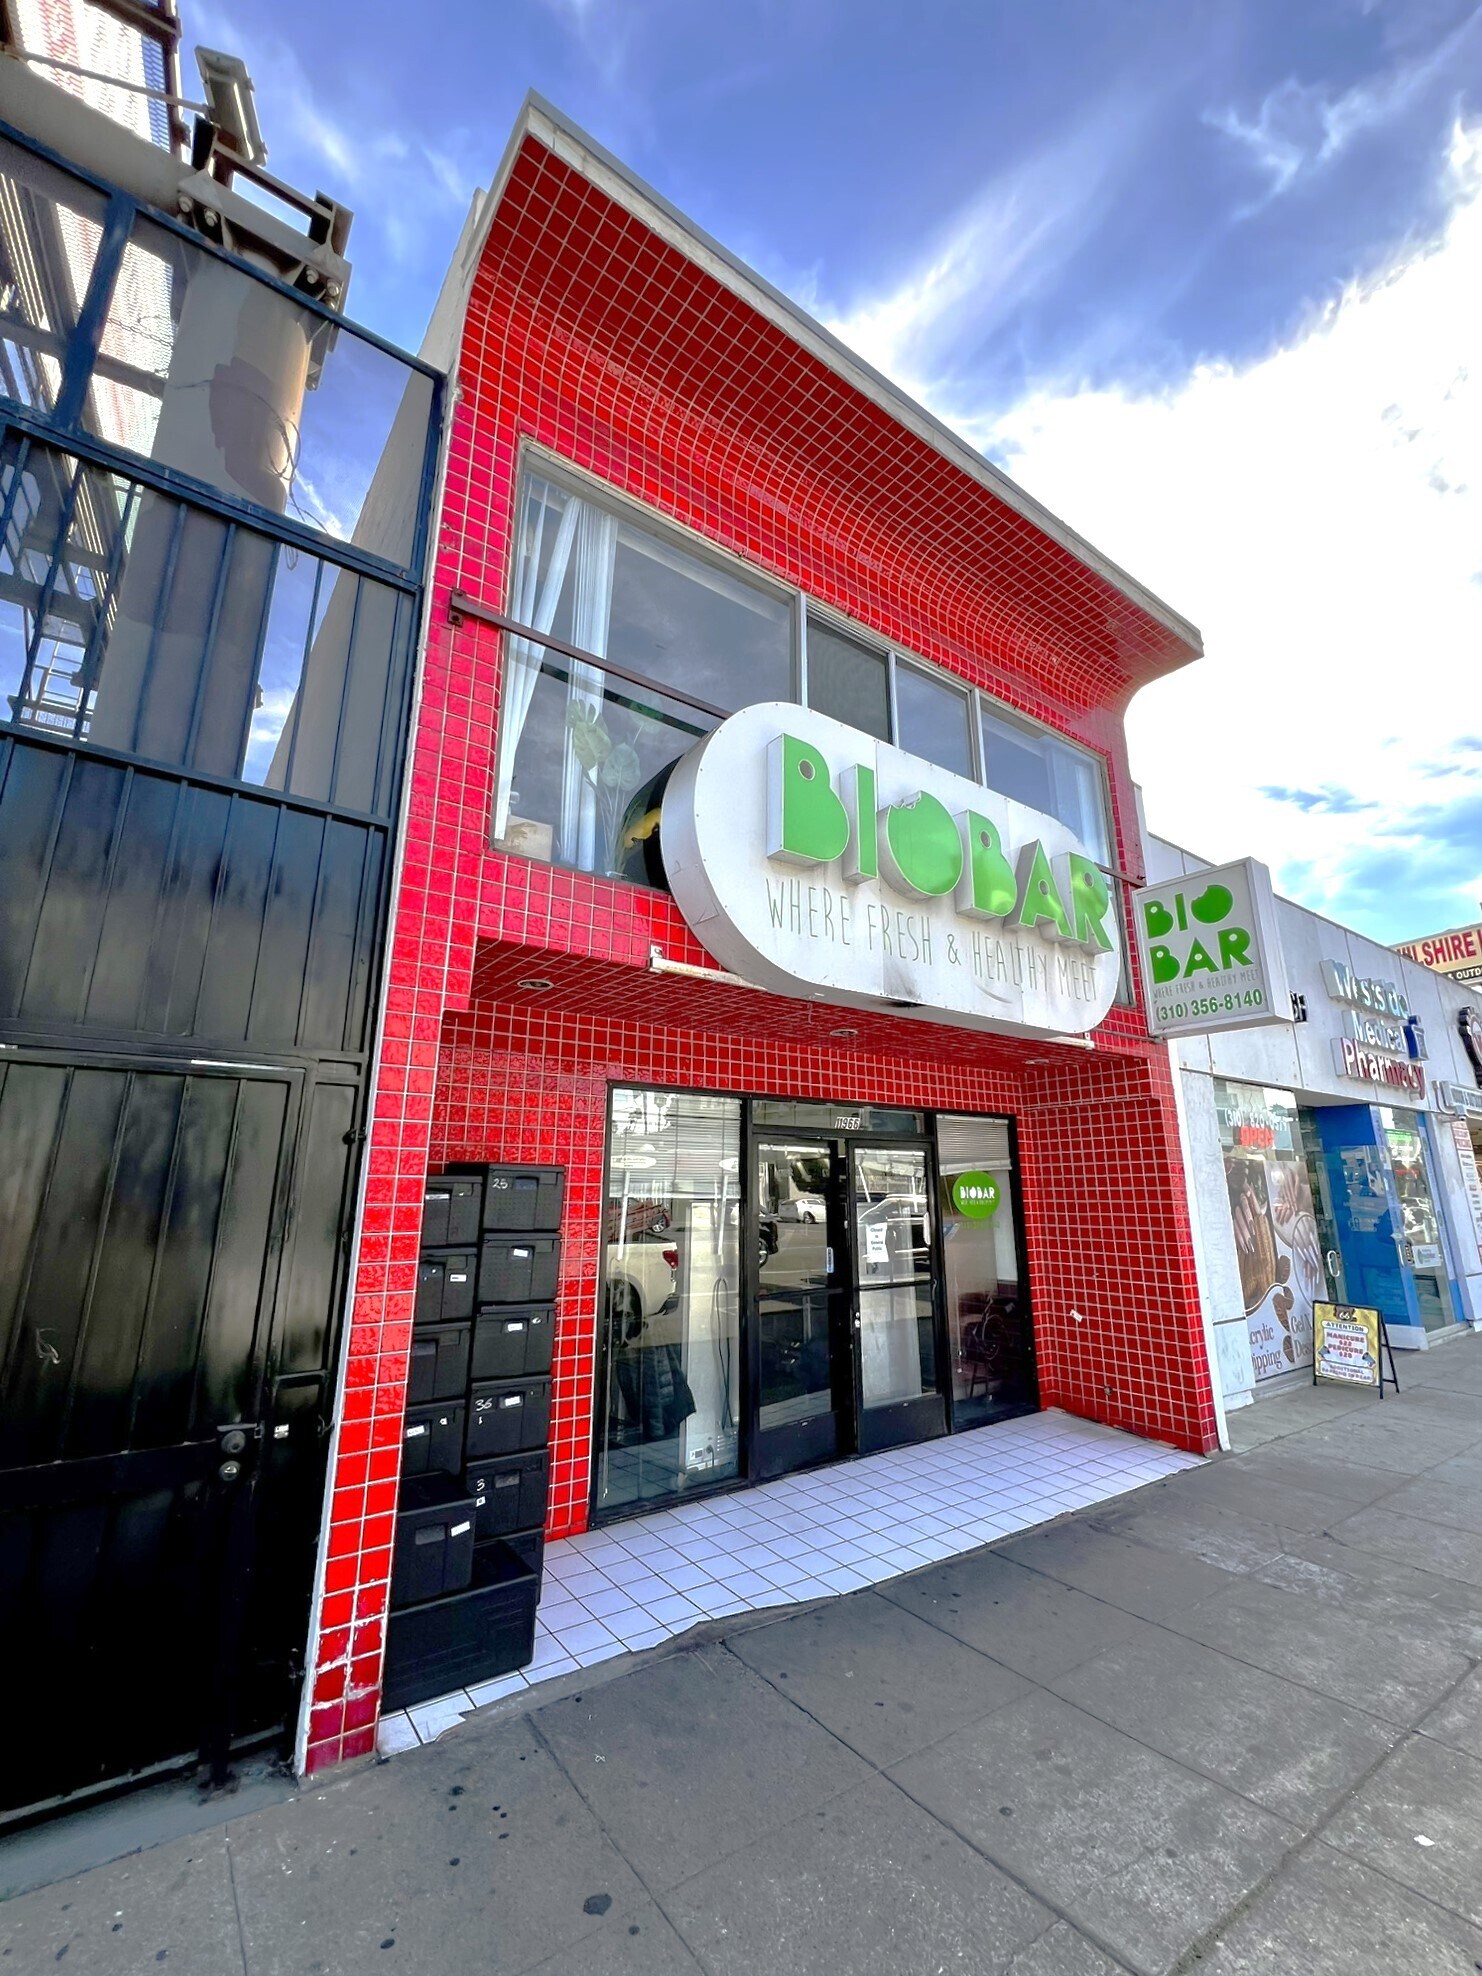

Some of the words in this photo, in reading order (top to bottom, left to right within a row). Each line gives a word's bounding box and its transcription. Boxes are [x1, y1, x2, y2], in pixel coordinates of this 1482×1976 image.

[767, 733, 1114, 954] BIOBAR
[1143, 884, 1234, 939] BIO
[766, 878, 851, 946] WHERE
[867, 904, 932, 966] FRESH
[947, 933, 962, 966] &
[972, 931, 1048, 992] HEALTHY
[1057, 956, 1097, 1002] MEET
[1149, 927, 1255, 984] BAR
[1153, 986, 1173, 999] WHERE
[1240, 968, 1260, 982] MEET
[1456, 966, 1482, 979] OUTD
[1156, 1002, 1189, 1022] (310)
[1191, 988, 1263, 1017] 356-8140
[1351, 1010, 1407, 1052] Medical
[1341, 1037, 1425, 1100] Pharmacy
[835, 1117, 860, 1129] 11966
[1225, 1108, 1245, 1128] (310)
[1240, 1126, 1274, 1149] OPEN
[959, 1186, 995, 1199] BIOBAR
[1249, 1323, 1275, 1349] crylic
[1326, 1321, 1364, 1332] ATTENTION
[1326, 1332, 1365, 1343] MANICURE
[1327, 1343, 1364, 1354] PEDICURE
[1251, 1349, 1282, 1375] ipping
